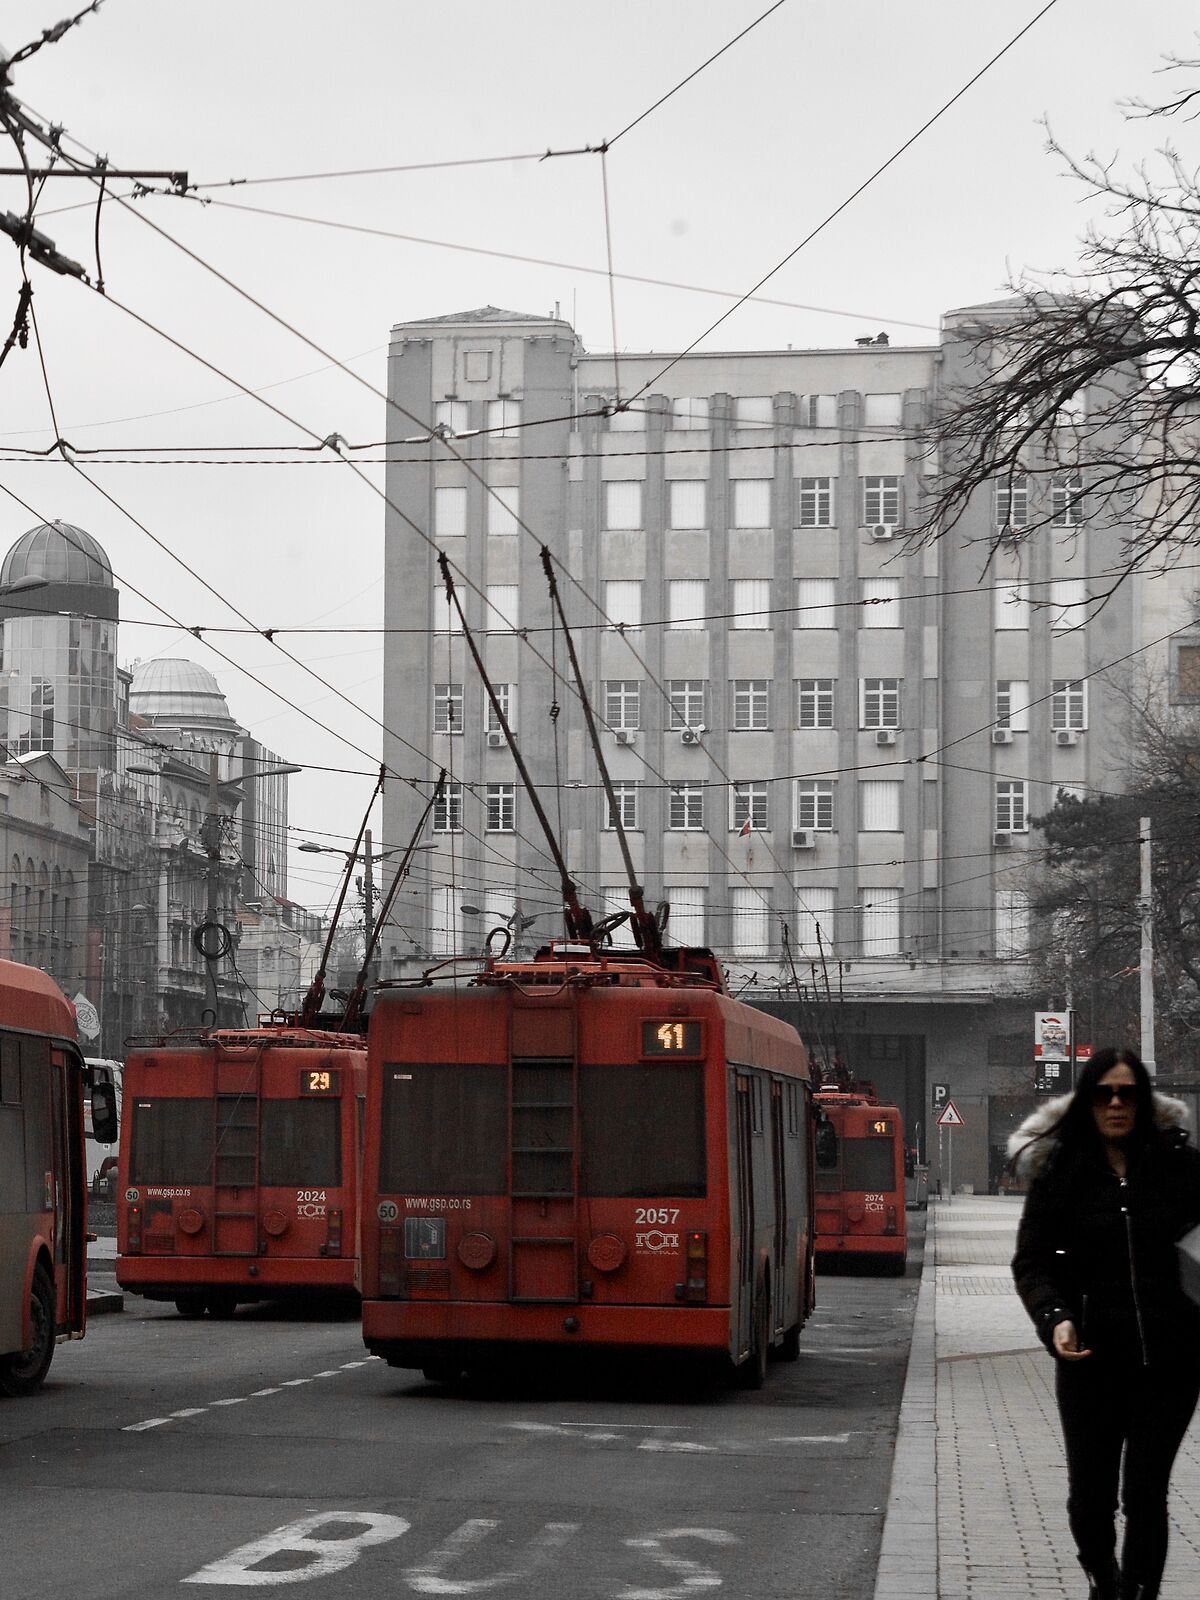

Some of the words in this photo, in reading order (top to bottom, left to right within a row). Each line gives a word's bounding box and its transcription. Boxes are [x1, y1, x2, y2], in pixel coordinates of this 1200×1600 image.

[657, 1023, 683, 1049] 41
[310, 1072, 330, 1090] 29
[935, 1086, 947, 1101] P
[874, 1121, 886, 1133] 41
[126, 1191, 138, 1200] 50
[147, 1188, 191, 1199] www.gsp.co.rs
[297, 1190, 327, 1202] 2024
[864, 1194, 884, 1202] 2074
[379, 1205, 397, 1219] 50
[404, 1198, 472, 1212] www.gsp.co.rs
[634, 1208, 680, 1225] 2057
[179, 1510, 742, 1600] BUS
